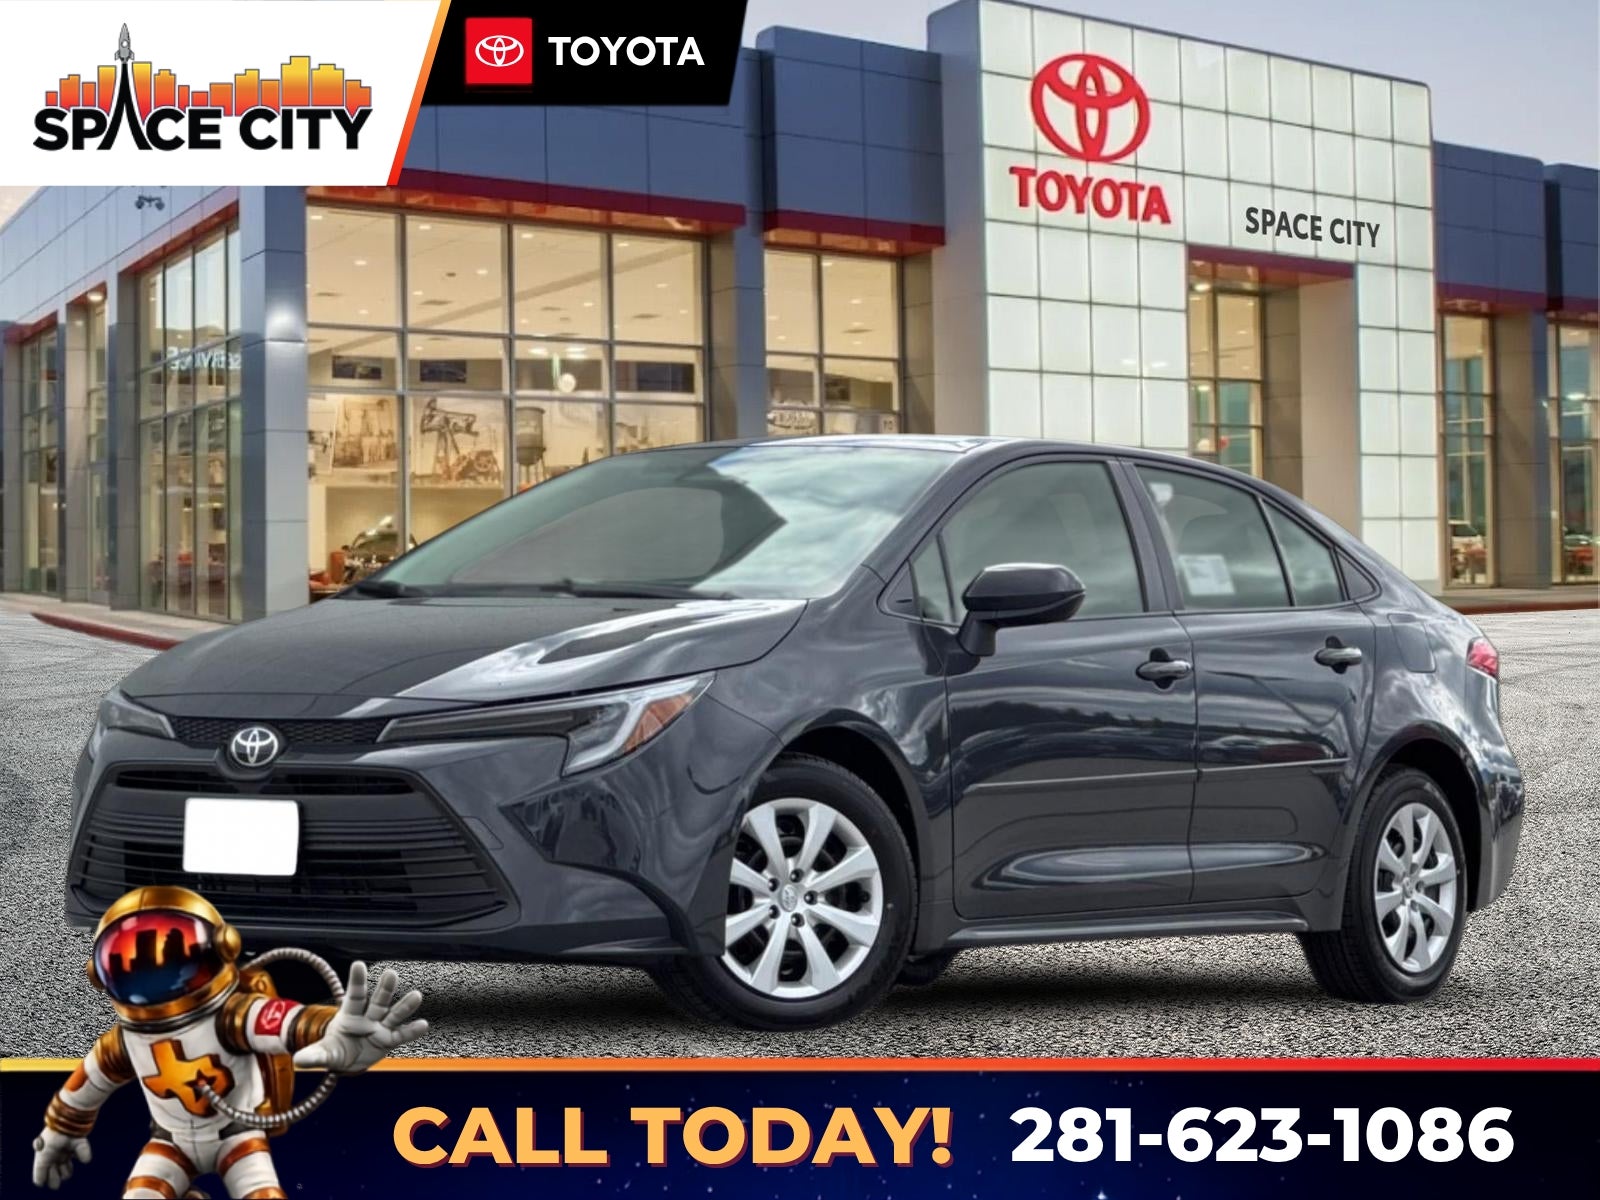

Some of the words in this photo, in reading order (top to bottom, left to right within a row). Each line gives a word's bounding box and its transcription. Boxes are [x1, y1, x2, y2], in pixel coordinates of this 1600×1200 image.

[1009, 166, 1171, 224] TOYOTA
[1245, 206, 1323, 242] SPACE
[1329, 217, 1381, 248] CITY
